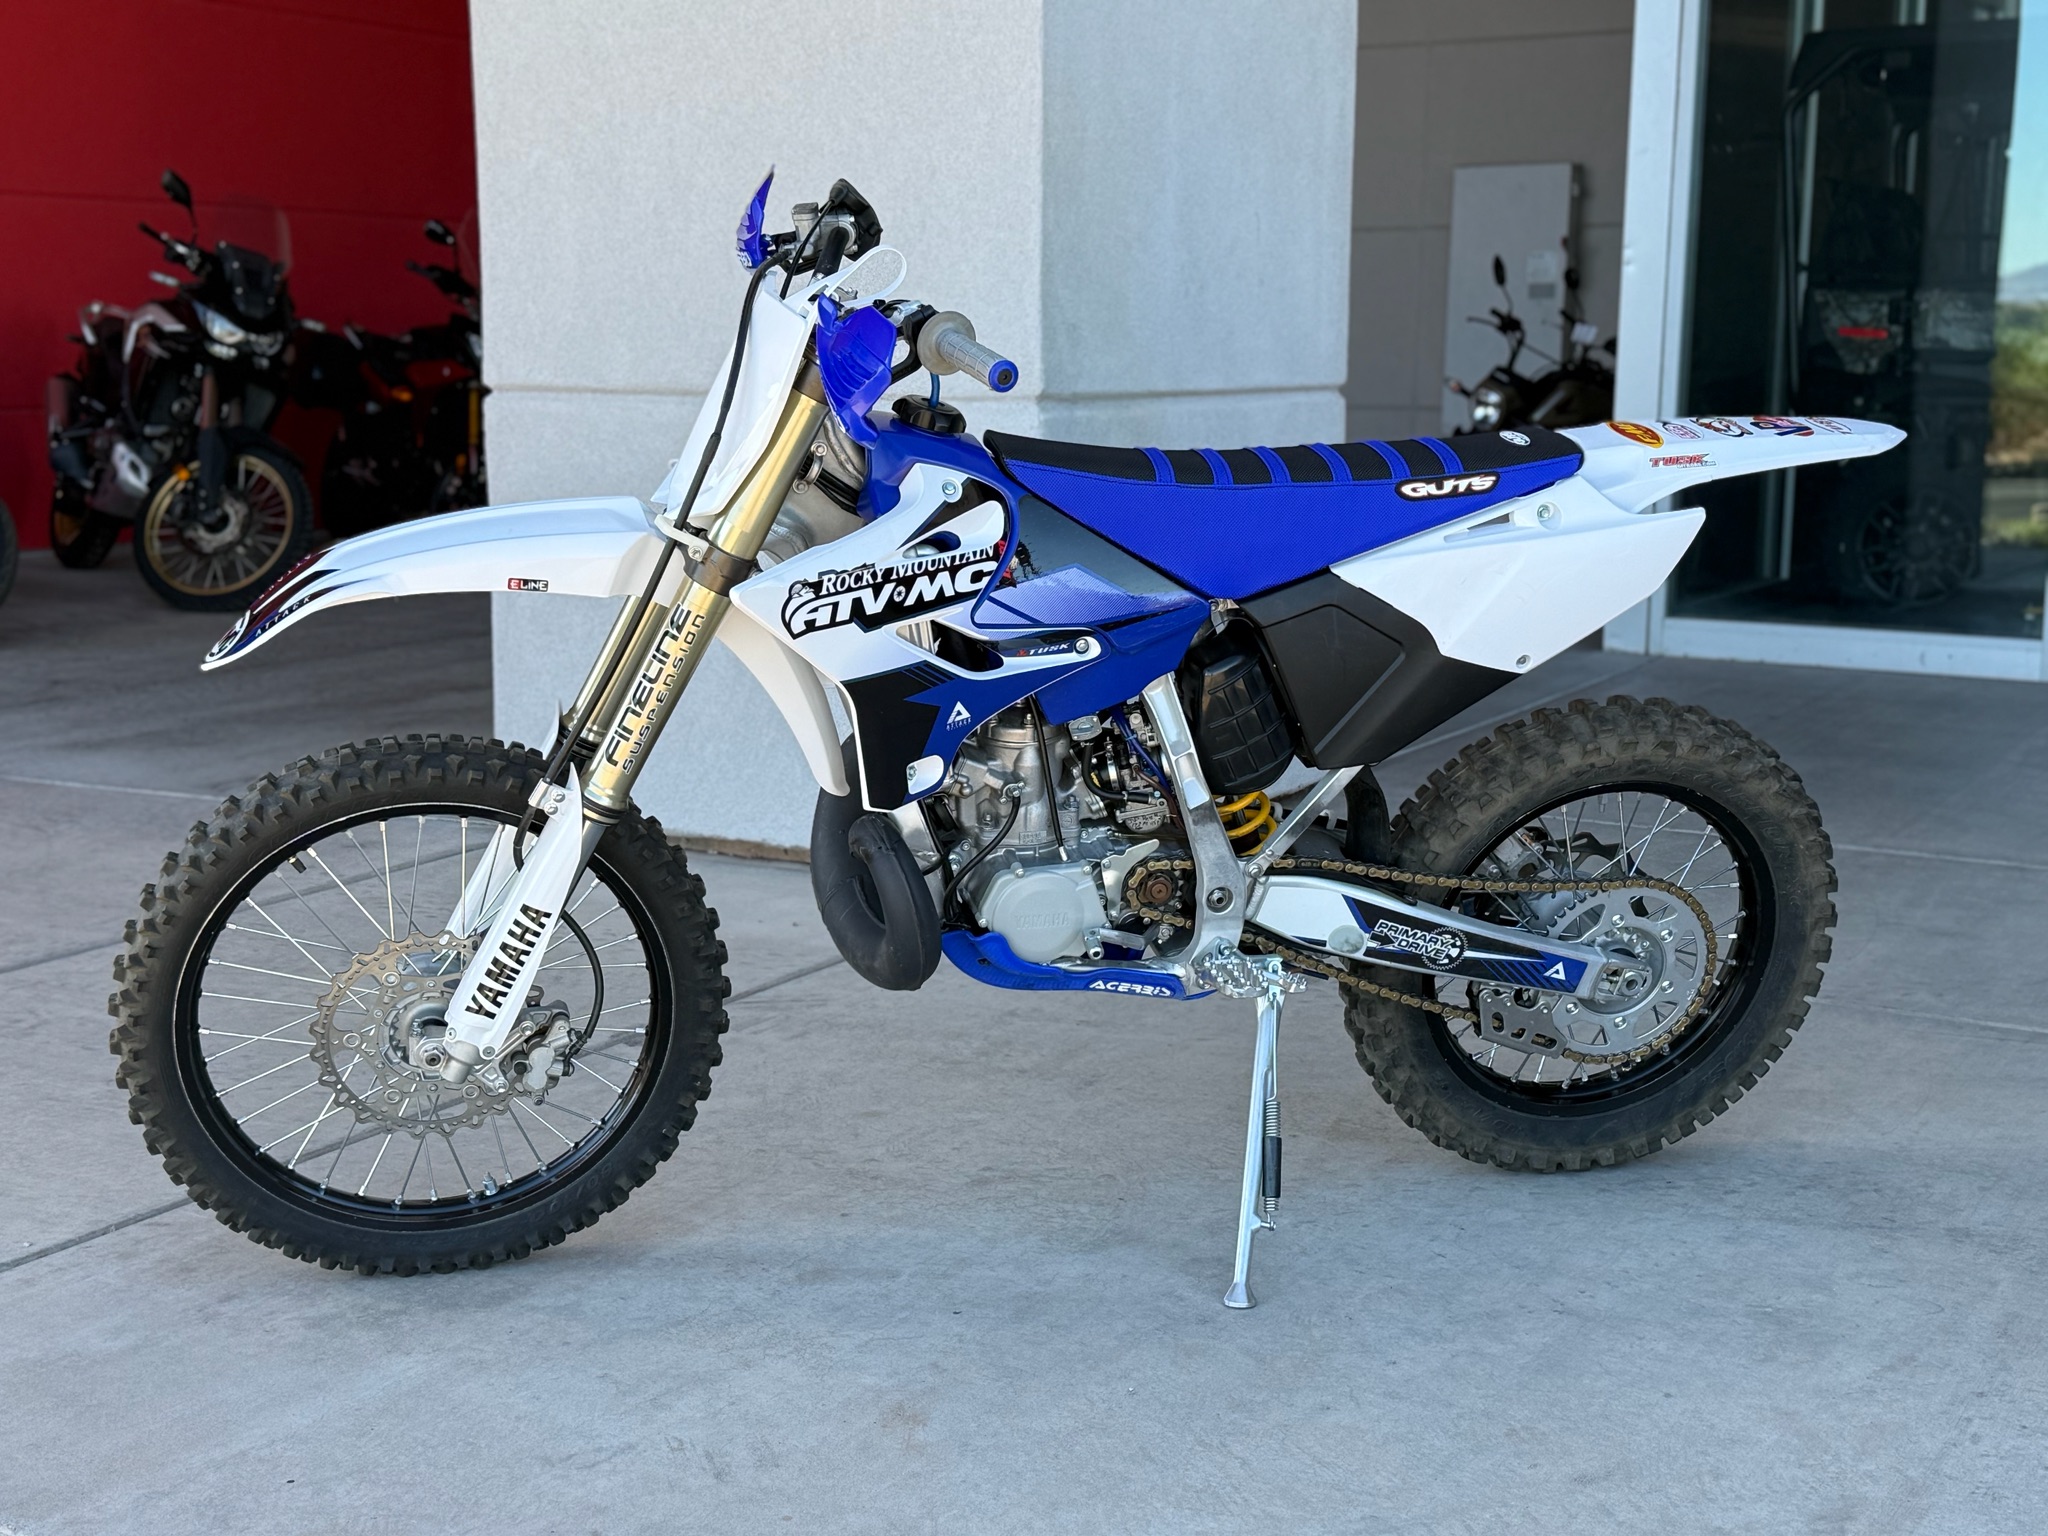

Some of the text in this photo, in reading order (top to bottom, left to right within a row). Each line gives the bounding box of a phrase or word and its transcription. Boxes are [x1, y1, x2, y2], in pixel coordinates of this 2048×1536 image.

[820, 545, 996, 596] ROCKY MOUNTAIN
[1029, 642, 1070, 656] TUSK
[1014, 911, 1070, 930] YAMAHA
[1375, 920, 1455, 948] PRIMARY
[465, 903, 553, 1020] YAMAHA
[1396, 938, 1448, 960] DRIVE
